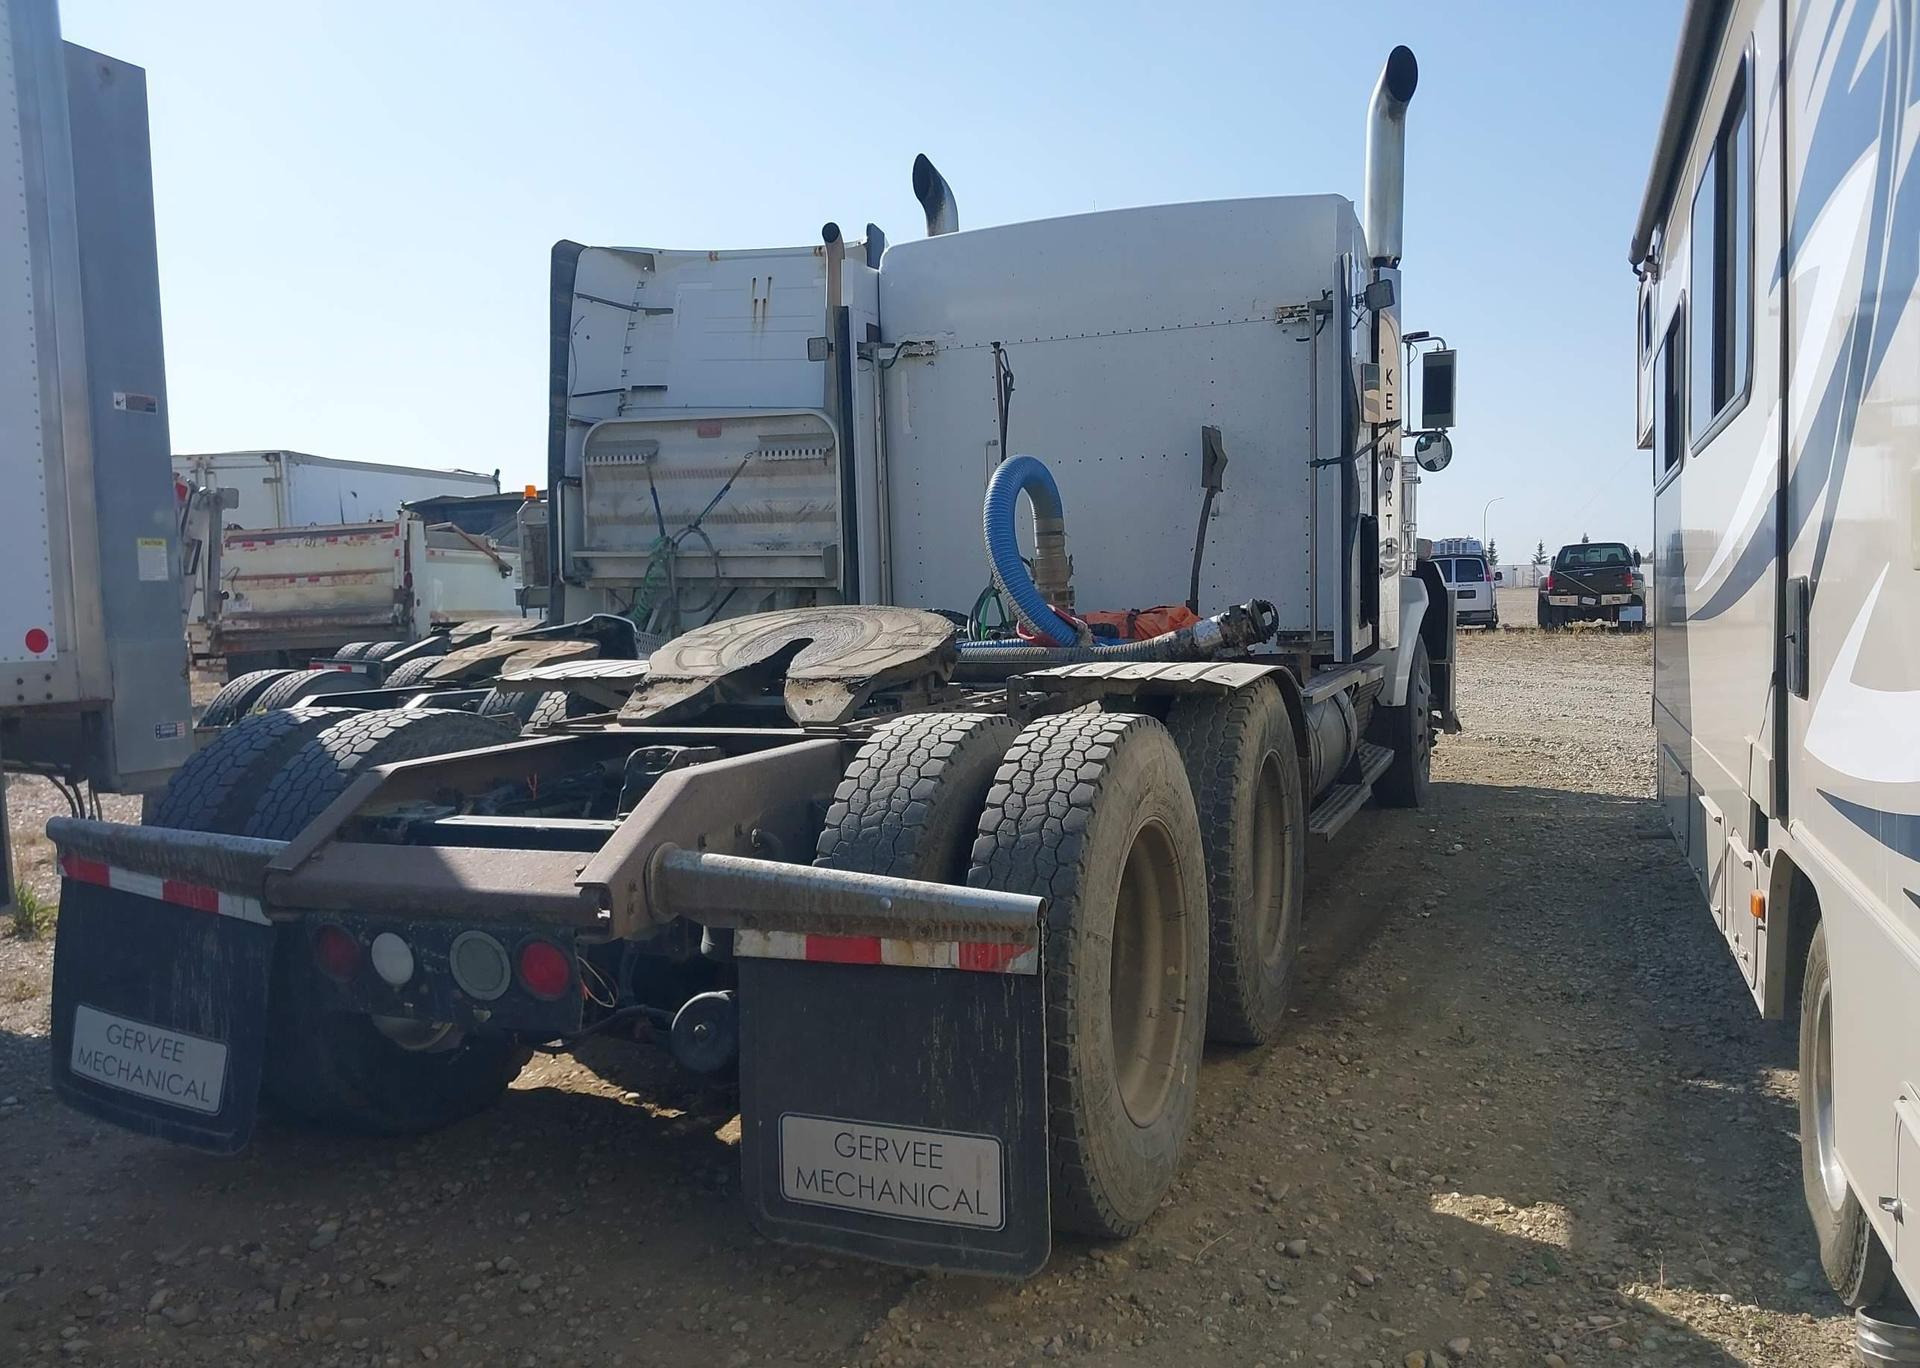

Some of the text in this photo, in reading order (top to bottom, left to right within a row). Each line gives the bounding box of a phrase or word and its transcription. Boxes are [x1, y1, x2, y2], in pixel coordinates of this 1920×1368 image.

[106, 1024, 185, 1062] GERVEE
[78, 1047, 209, 1102] MECHANICAL
[834, 1132, 943, 1169] GERVEE
[796, 1166, 988, 1215] MECHANICAL
